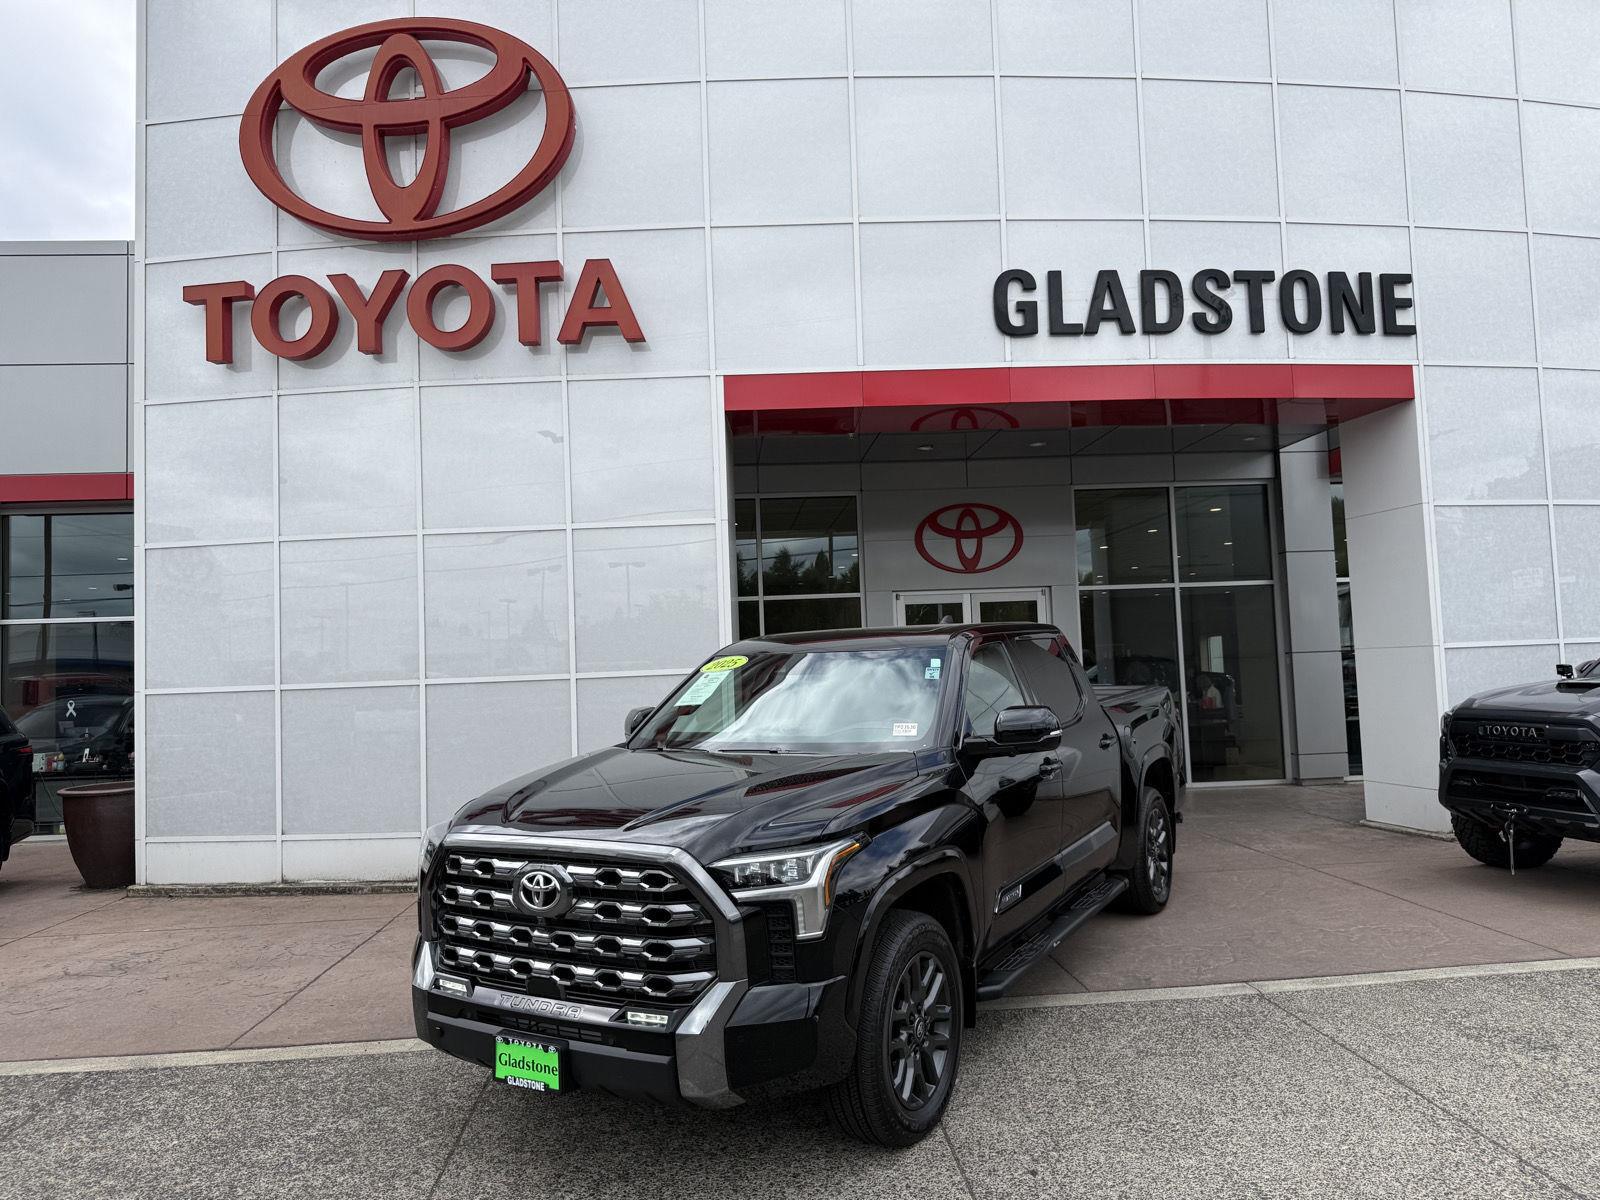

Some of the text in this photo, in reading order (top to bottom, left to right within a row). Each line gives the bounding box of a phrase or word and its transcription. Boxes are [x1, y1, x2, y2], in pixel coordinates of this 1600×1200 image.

[183, 258, 647, 365] TOYOTA
[993, 268, 1417, 336] GLADSTONE
[1485, 725, 1537, 738] TOYOTA
[500, 994, 582, 1019] TUNDRA
[508, 1038, 543, 1050] TOYOTA
[498, 1052, 558, 1076] Gladstone
[507, 1076, 545, 1092] GLADSTONE
